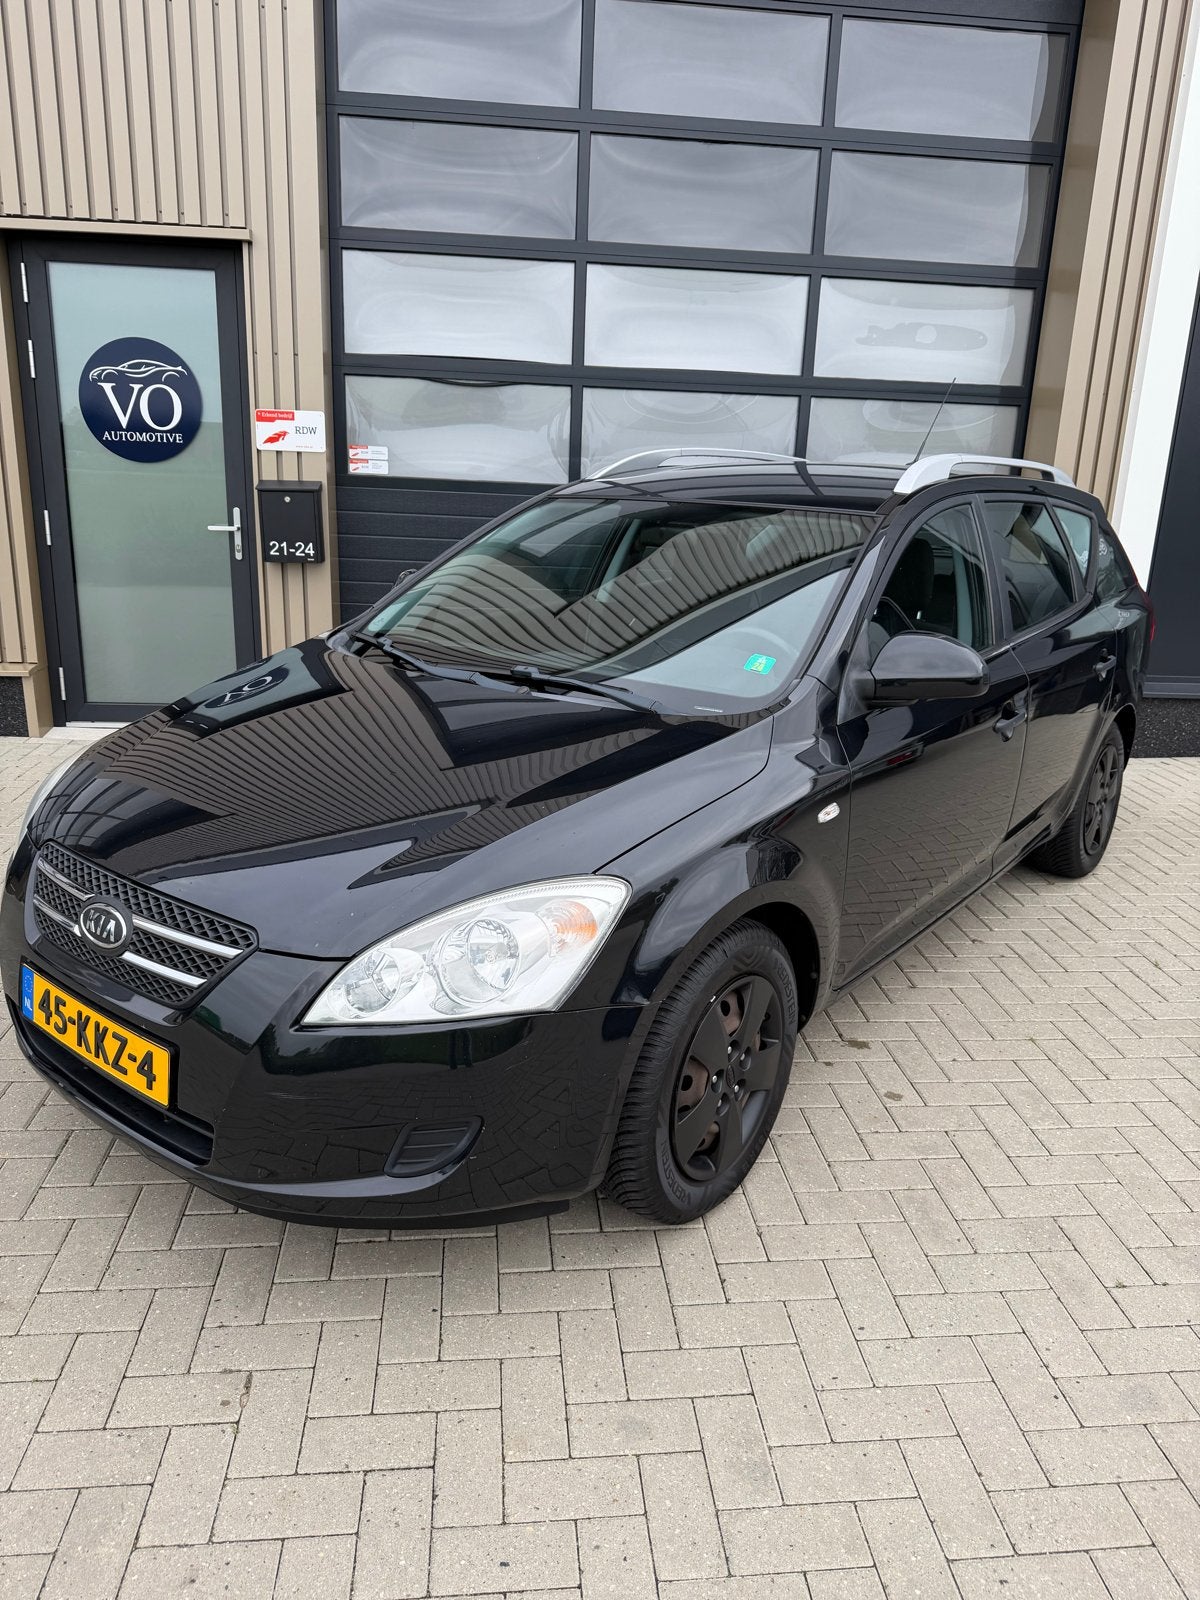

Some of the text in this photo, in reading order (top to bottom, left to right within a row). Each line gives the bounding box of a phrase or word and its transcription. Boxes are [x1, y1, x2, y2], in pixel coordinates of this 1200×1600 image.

[98, 382, 182, 431] VO
[103, 430, 184, 444] AUTOMOTIVE
[295, 426, 317, 435] RDW
[269, 540, 315, 557] 21-24
[86, 909, 116, 942] KIA
[24, 995, 33, 1011] NL
[38, 988, 157, 1091] 45-KKZ-4
